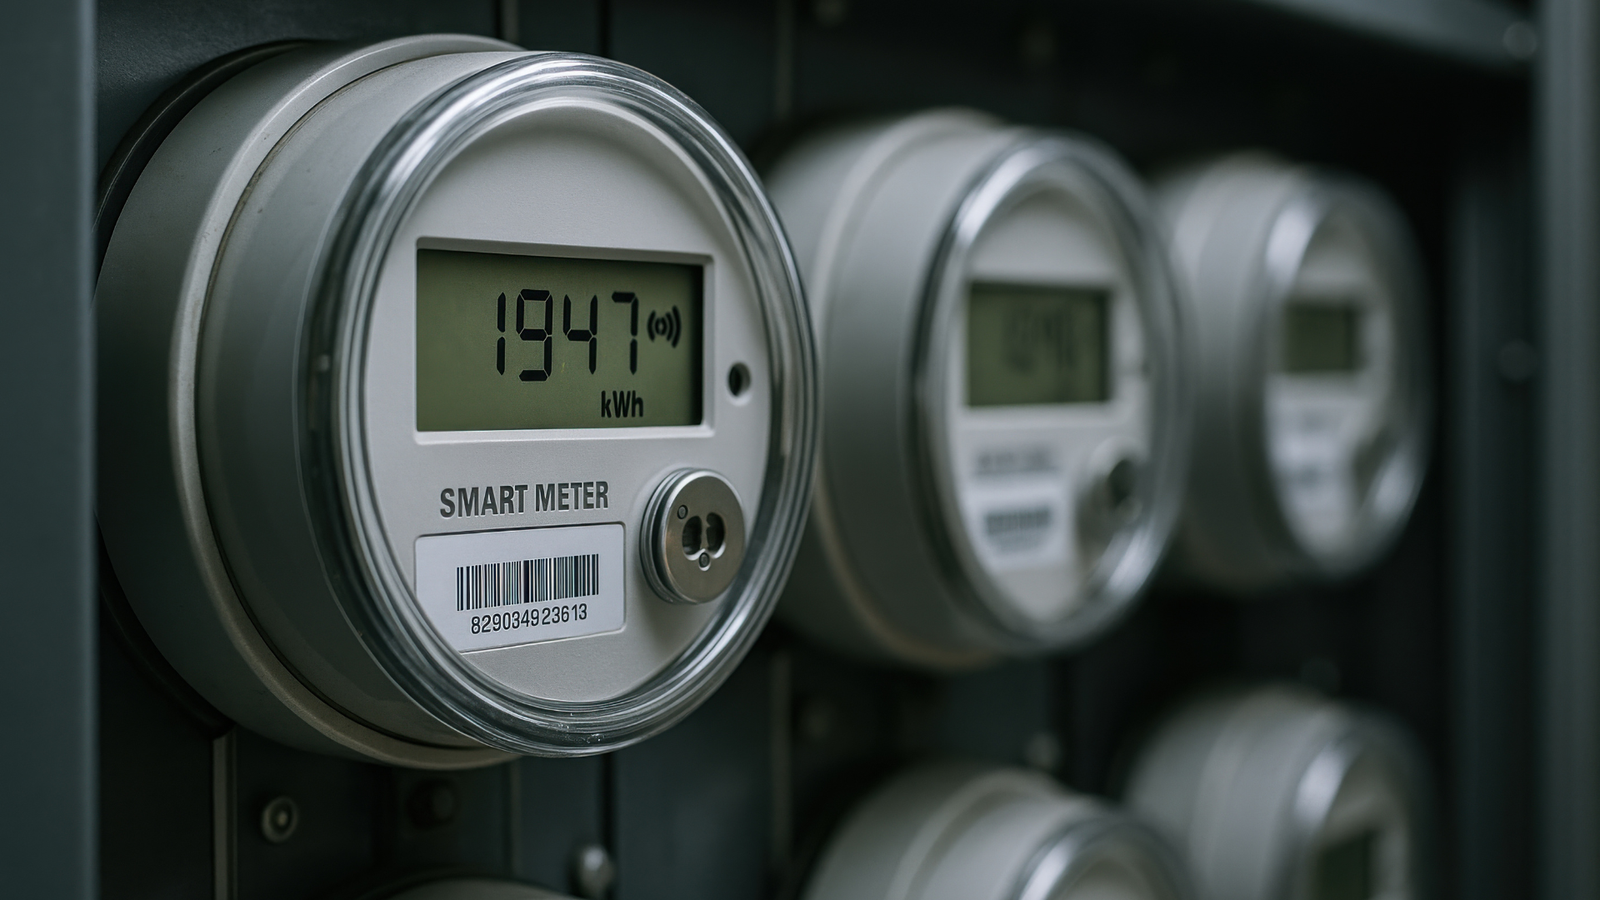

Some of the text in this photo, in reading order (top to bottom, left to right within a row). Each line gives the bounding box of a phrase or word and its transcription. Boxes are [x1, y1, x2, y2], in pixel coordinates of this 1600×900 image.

[497, 289, 639, 381] 1947
[601, 390, 644, 418] kWh
[440, 481, 609, 518] SMART METER
[471, 603, 588, 634] 829034923613
